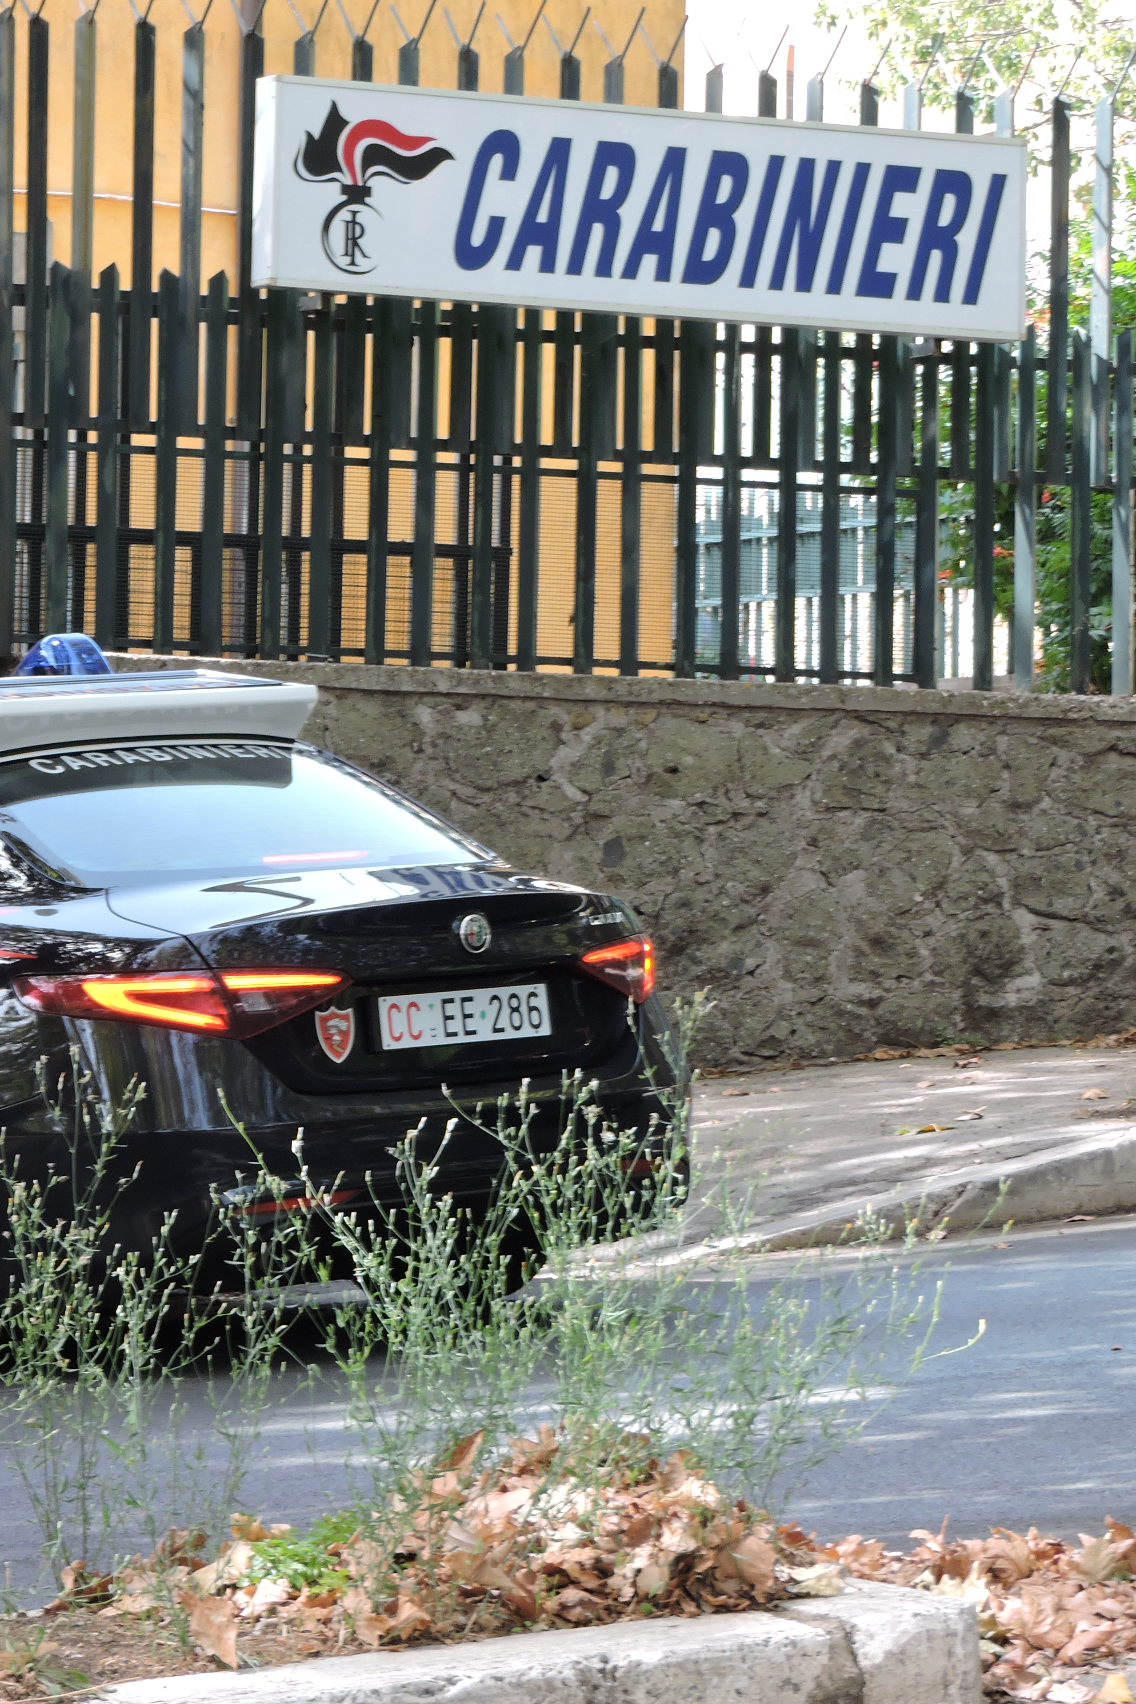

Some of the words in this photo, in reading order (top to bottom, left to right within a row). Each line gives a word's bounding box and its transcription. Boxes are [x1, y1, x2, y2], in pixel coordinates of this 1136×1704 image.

[454, 128, 1008, 306] CARABINIERI
[28, 743, 292, 775] CARABINIERI
[387, 1001, 423, 1042] CC
[440, 996, 477, 1037] EE
[489, 991, 542, 1034] 286
